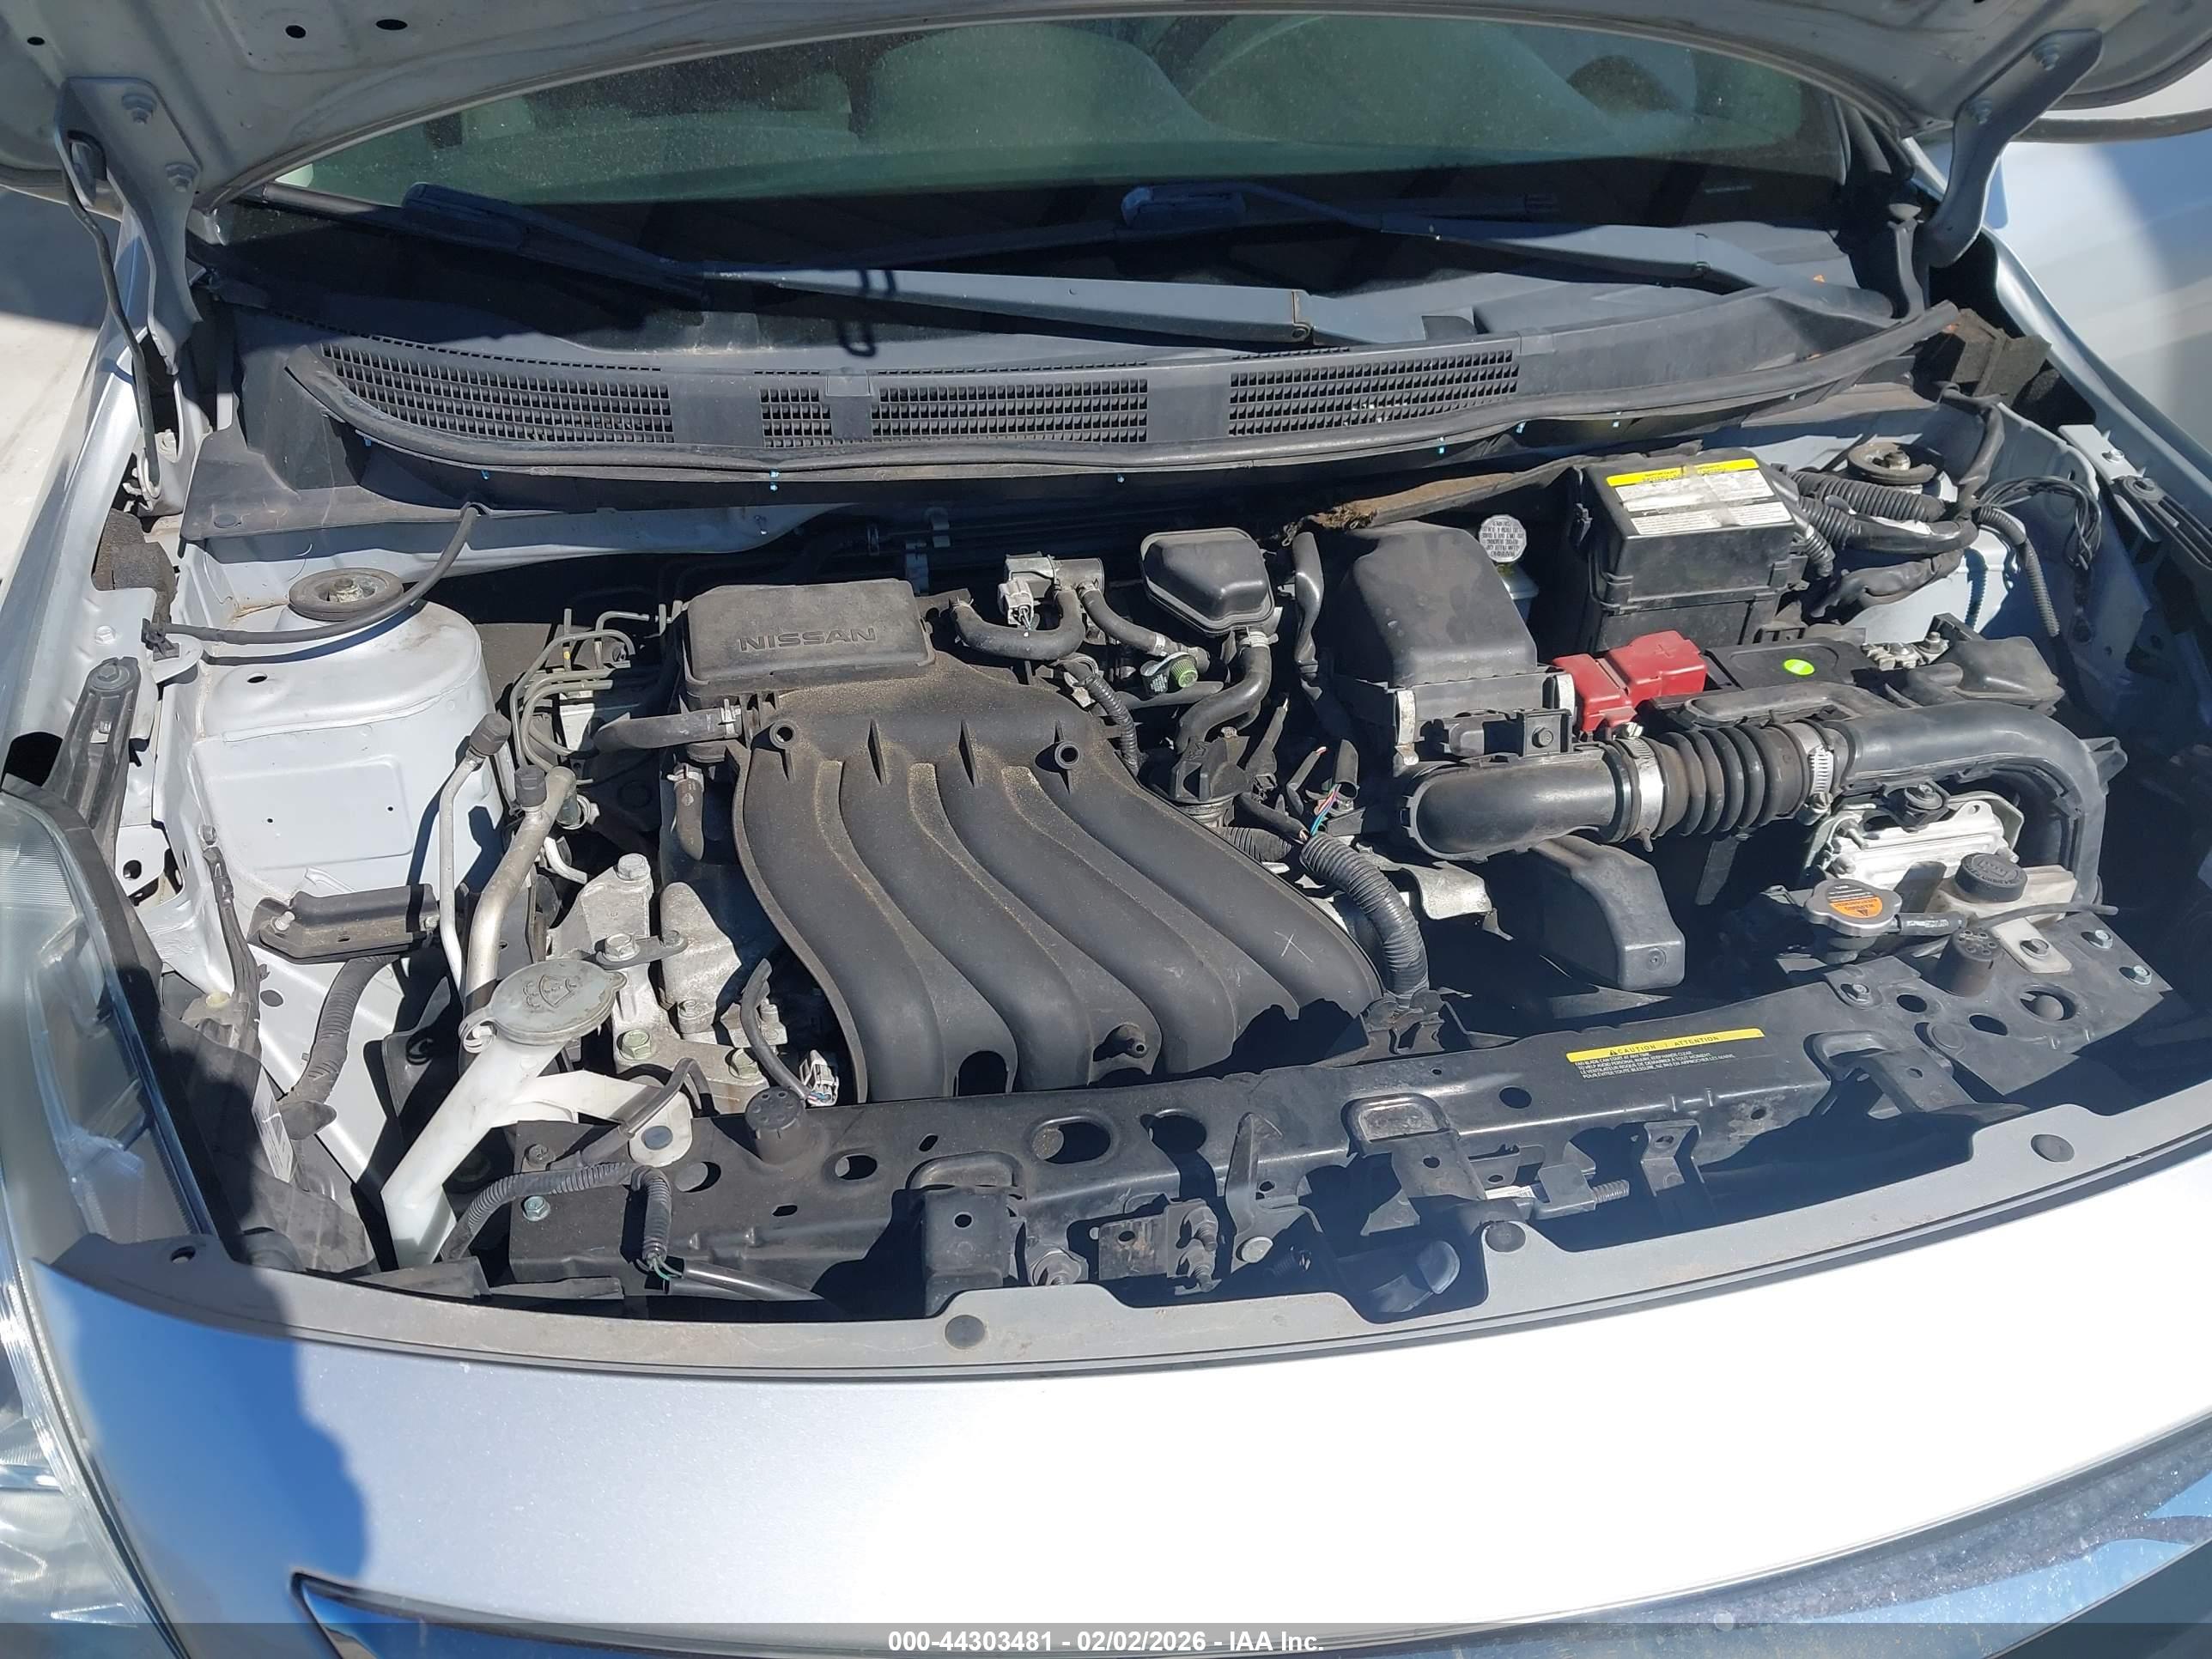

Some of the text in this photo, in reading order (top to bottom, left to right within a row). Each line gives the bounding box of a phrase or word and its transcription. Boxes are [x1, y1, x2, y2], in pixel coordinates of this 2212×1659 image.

[739, 628, 877, 652] NISSAN
[1617, 1044, 1656, 1054] CAUTION
[1673, 1036, 1719, 1046] ATTENTION
